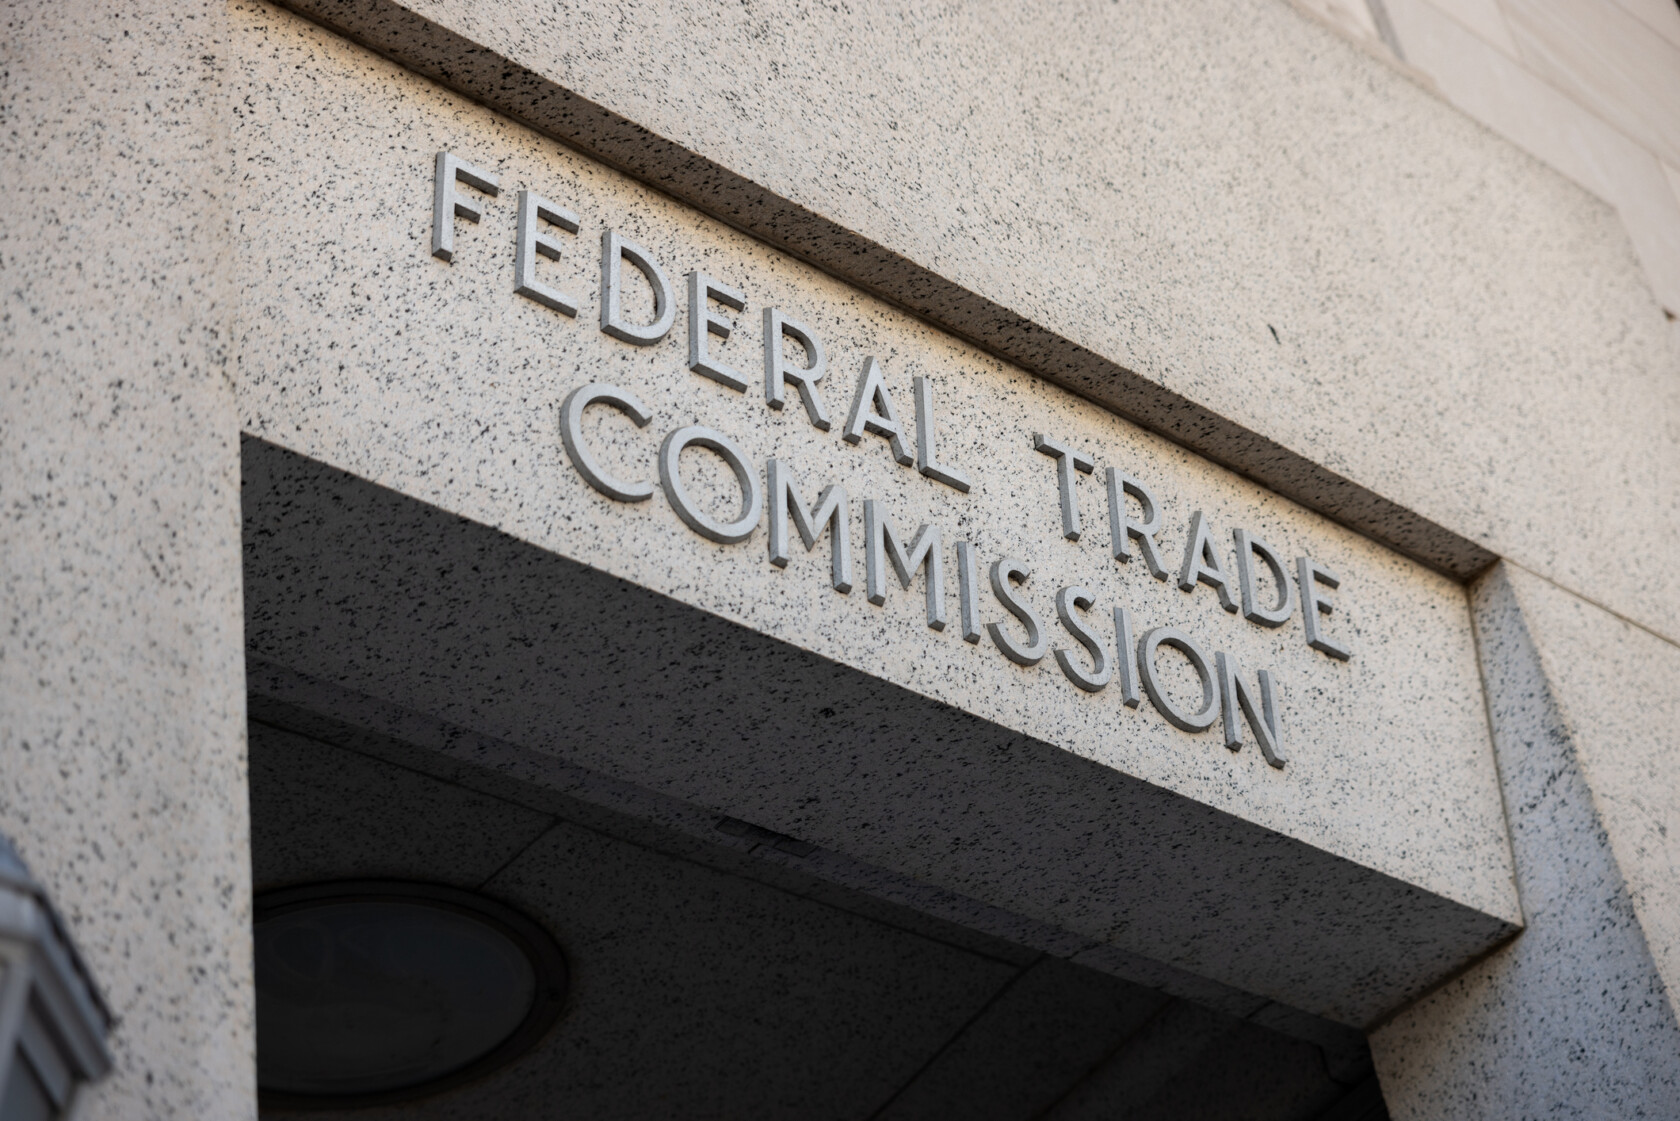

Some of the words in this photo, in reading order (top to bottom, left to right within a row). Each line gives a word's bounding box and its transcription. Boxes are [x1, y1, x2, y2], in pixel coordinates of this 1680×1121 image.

[431, 151, 971, 494] FEDERAL
[1034, 433, 1351, 662] TRADE
[560, 382, 1286, 769] COMMISSION
